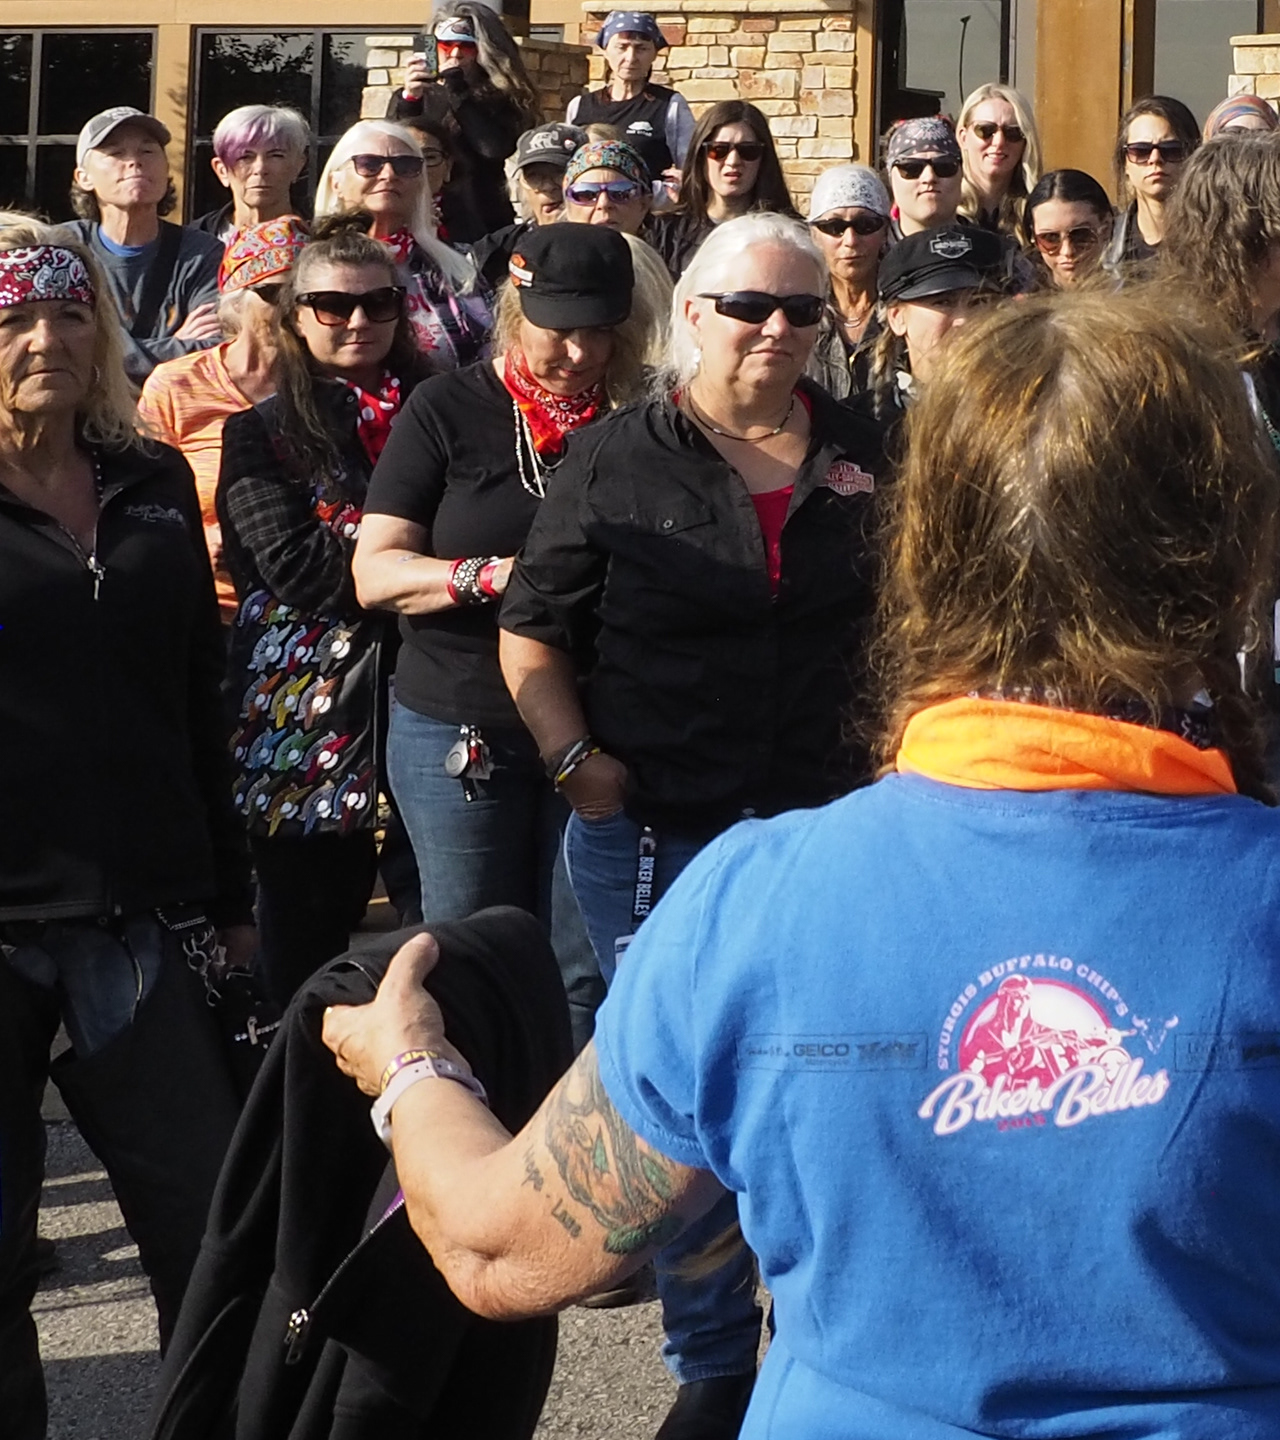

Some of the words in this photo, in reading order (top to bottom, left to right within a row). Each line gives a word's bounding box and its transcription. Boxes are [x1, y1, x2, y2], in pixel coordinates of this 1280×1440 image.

[637, 856, 654, 882] BIKER
[634, 883, 652, 916] BELLES
[937, 984, 978, 1070] STURGIS
[977, 953, 1074, 988] BUFFALO
[1075, 963, 1129, 1017] CHIP'S
[793, 1043, 849, 1057] GEICO
[917, 1070, 1052, 1136] Biker
[1045, 1057, 1170, 1128] Belles
